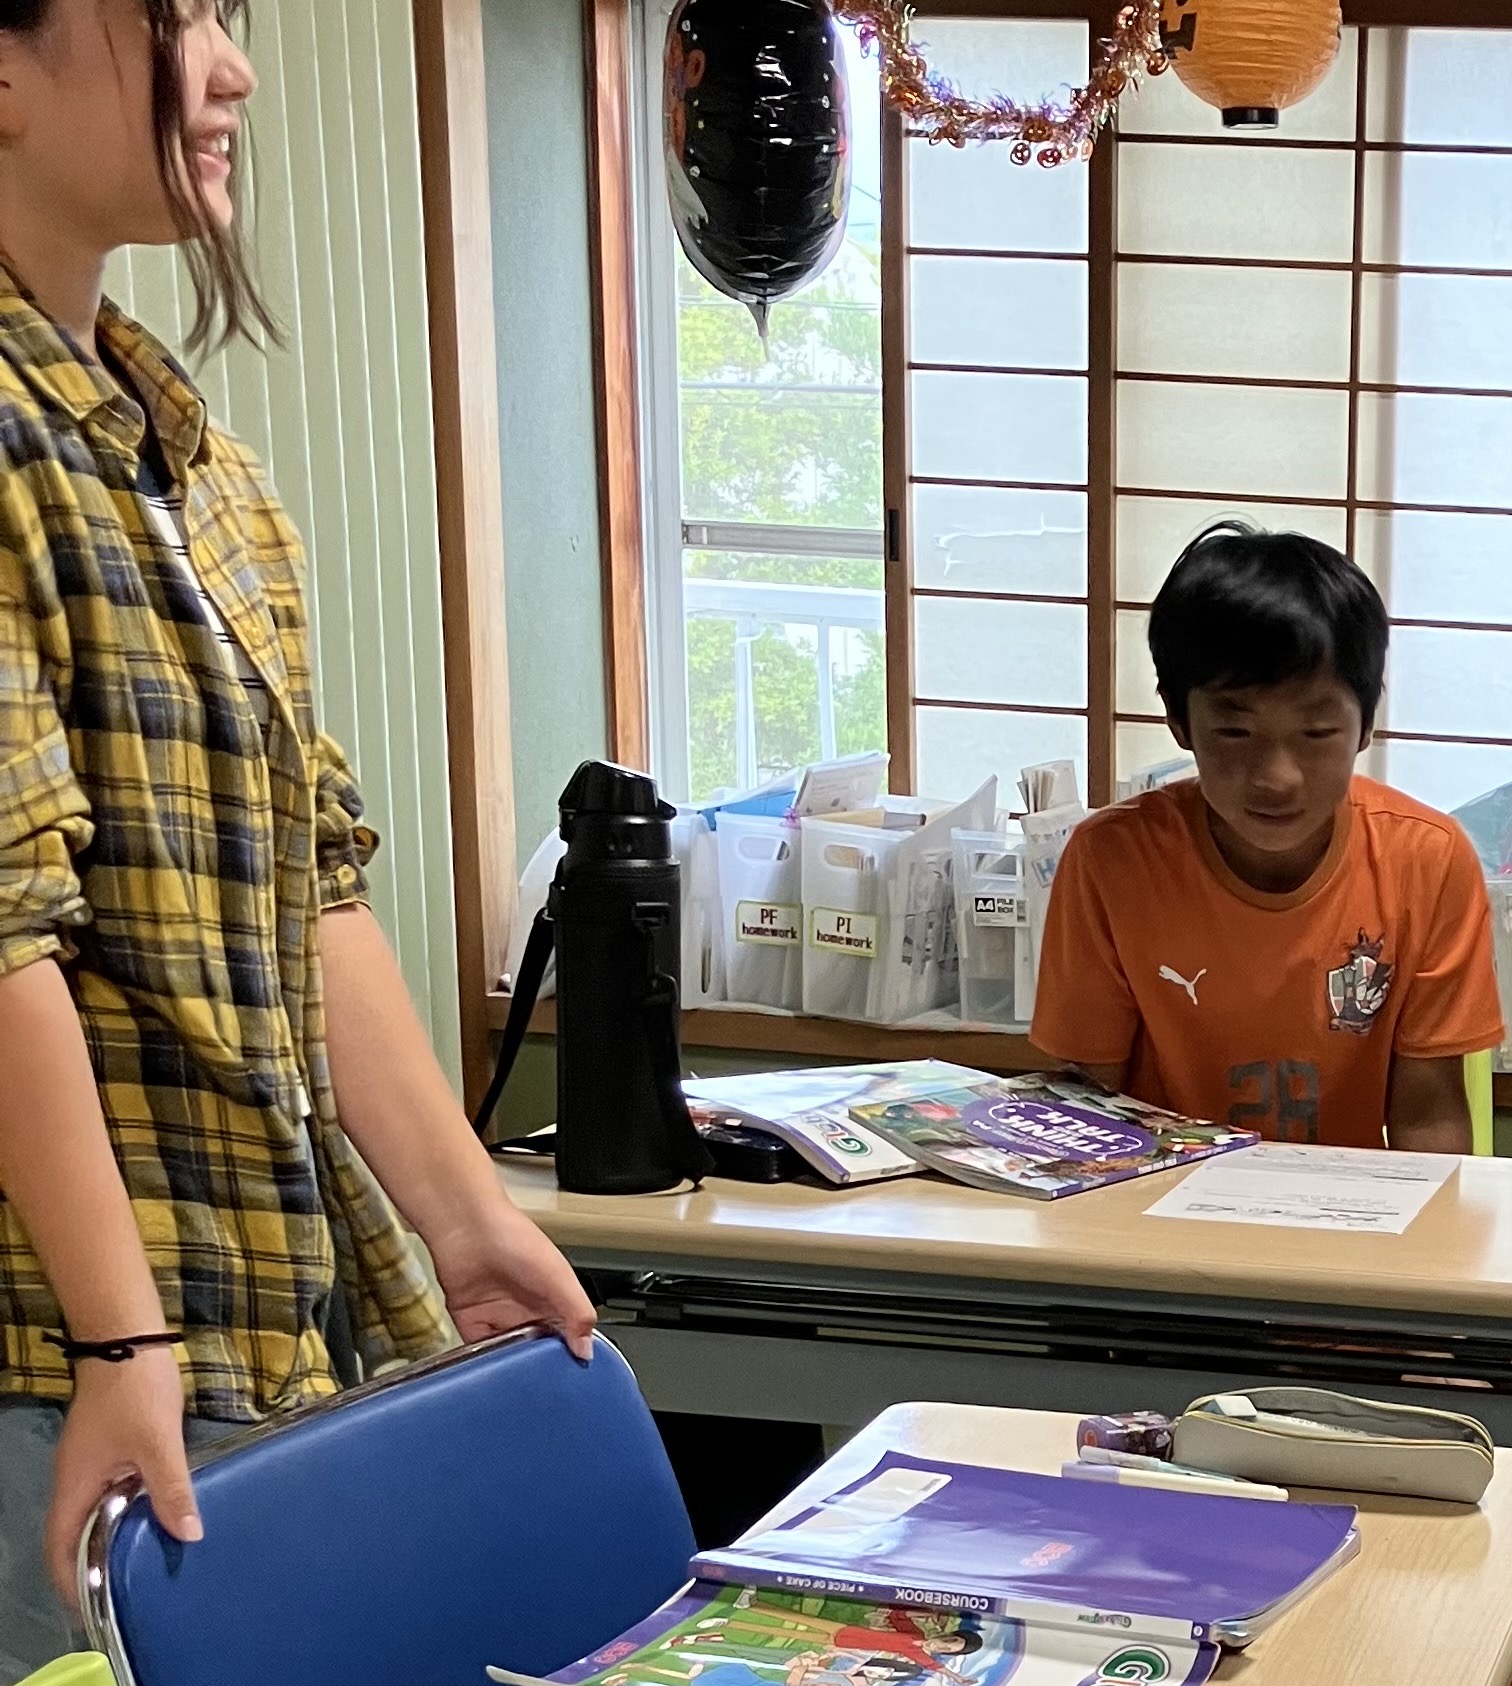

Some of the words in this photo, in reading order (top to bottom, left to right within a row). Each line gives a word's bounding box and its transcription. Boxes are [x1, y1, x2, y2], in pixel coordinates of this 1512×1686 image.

[976, 899, 994, 911] A4
[760, 908, 779, 926] PF
[836, 916, 852, 935] PI
[742, 922, 798, 940] homework
[816, 929, 873, 950] homework
[998, 1114, 1104, 1153] THINK
[1036, 1111, 1126, 1143] TALK
[894, 1587, 990, 1611] COURSEBOOK
